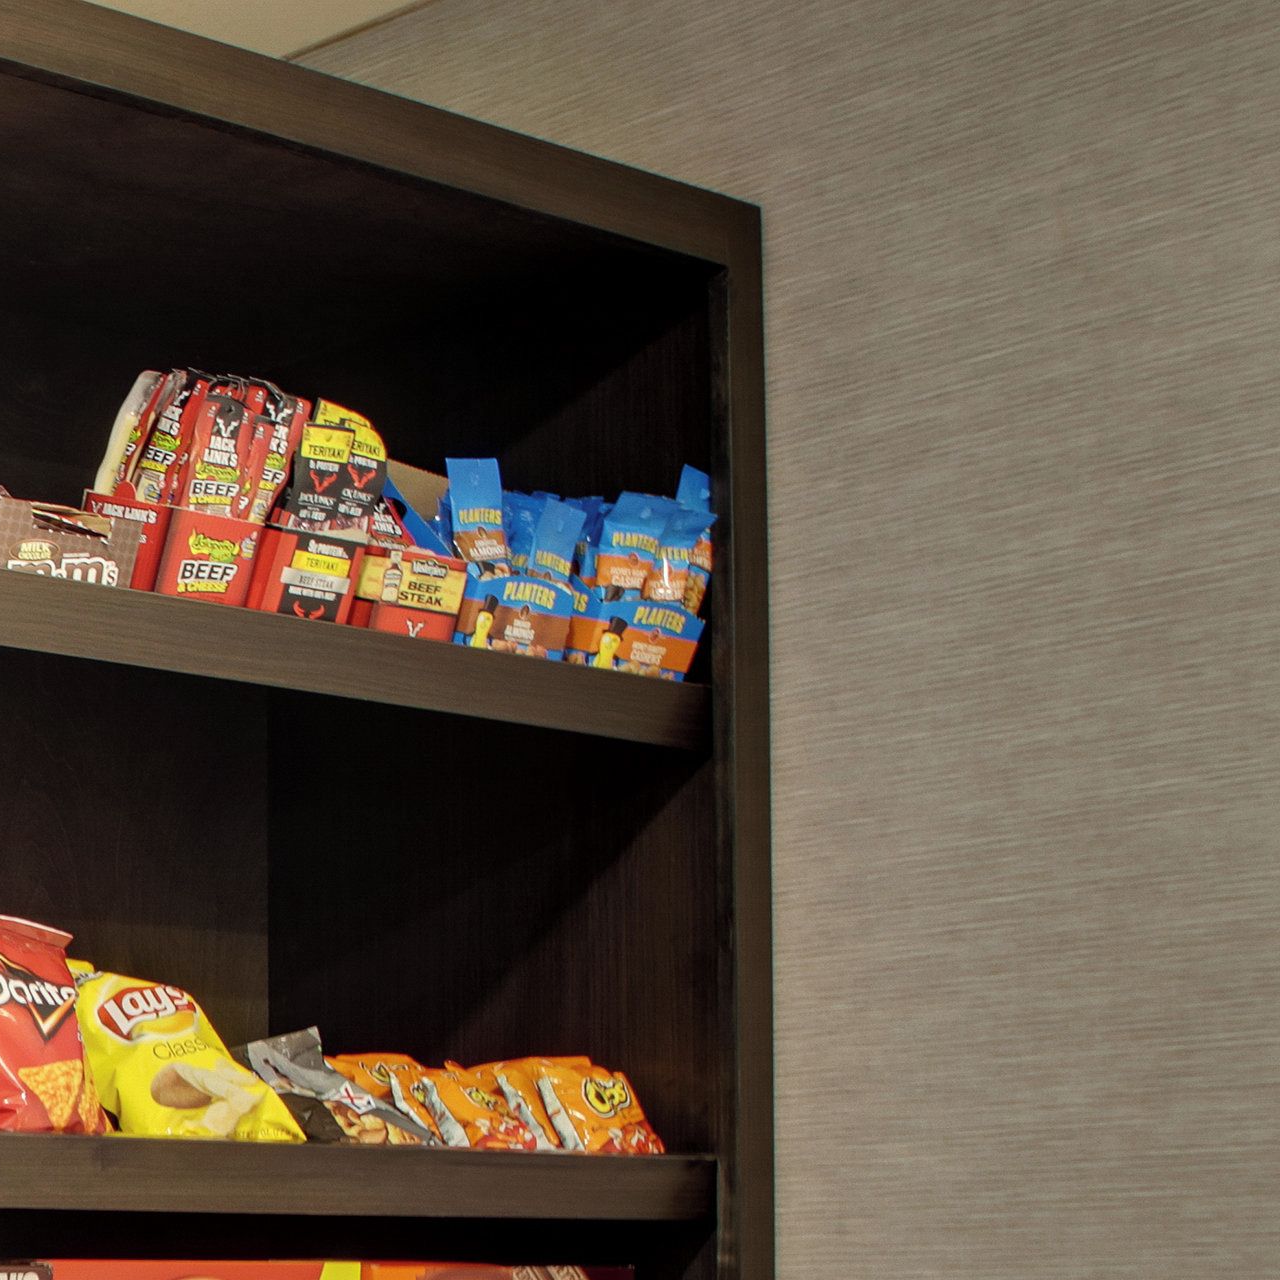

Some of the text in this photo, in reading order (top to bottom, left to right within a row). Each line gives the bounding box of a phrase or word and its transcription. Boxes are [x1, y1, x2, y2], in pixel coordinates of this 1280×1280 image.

[209, 435, 235, 452] JACK
[309, 444, 345, 458] TERIYAKI
[191, 481, 237, 496] BEEF
[459, 508, 502, 525] PLANTERS
[20, 542, 50, 552] MILK
[181, 562, 234, 581] BEEF
[306, 557, 339, 572] TERIYAKI
[408, 581, 442, 594] BEEF
[502, 581, 556, 610] PLANTERS
[398, 591, 443, 607] STEAK
[633, 606, 686, 634] PLANTERS
[104, 985, 189, 1036] Lay's
